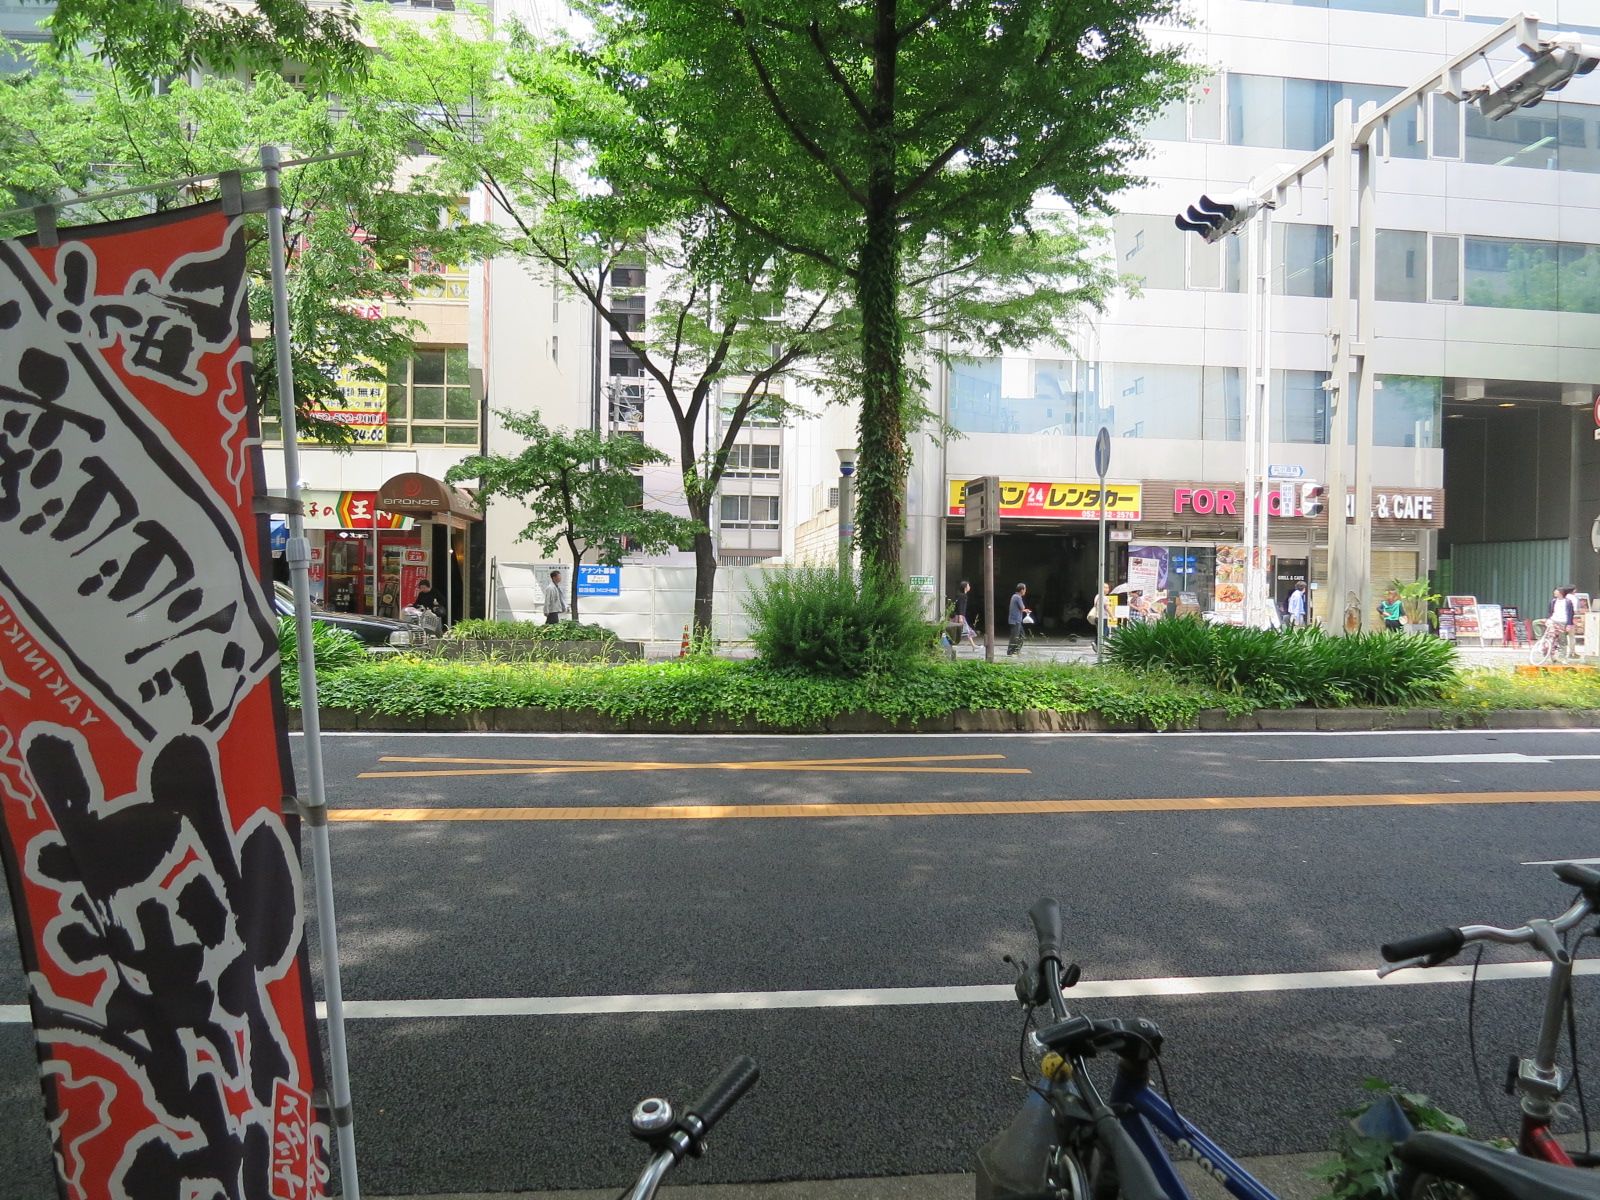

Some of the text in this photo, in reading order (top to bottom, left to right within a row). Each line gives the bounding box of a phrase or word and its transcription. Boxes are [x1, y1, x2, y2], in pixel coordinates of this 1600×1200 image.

[383, 498, 440, 506] BRONZE
[1027, 487, 1044, 503] 24
[1049, 488, 1133, 508] レンタカー
[1175, 488, 1237, 515] FOR
[1392, 495, 1433, 519] CAFE
